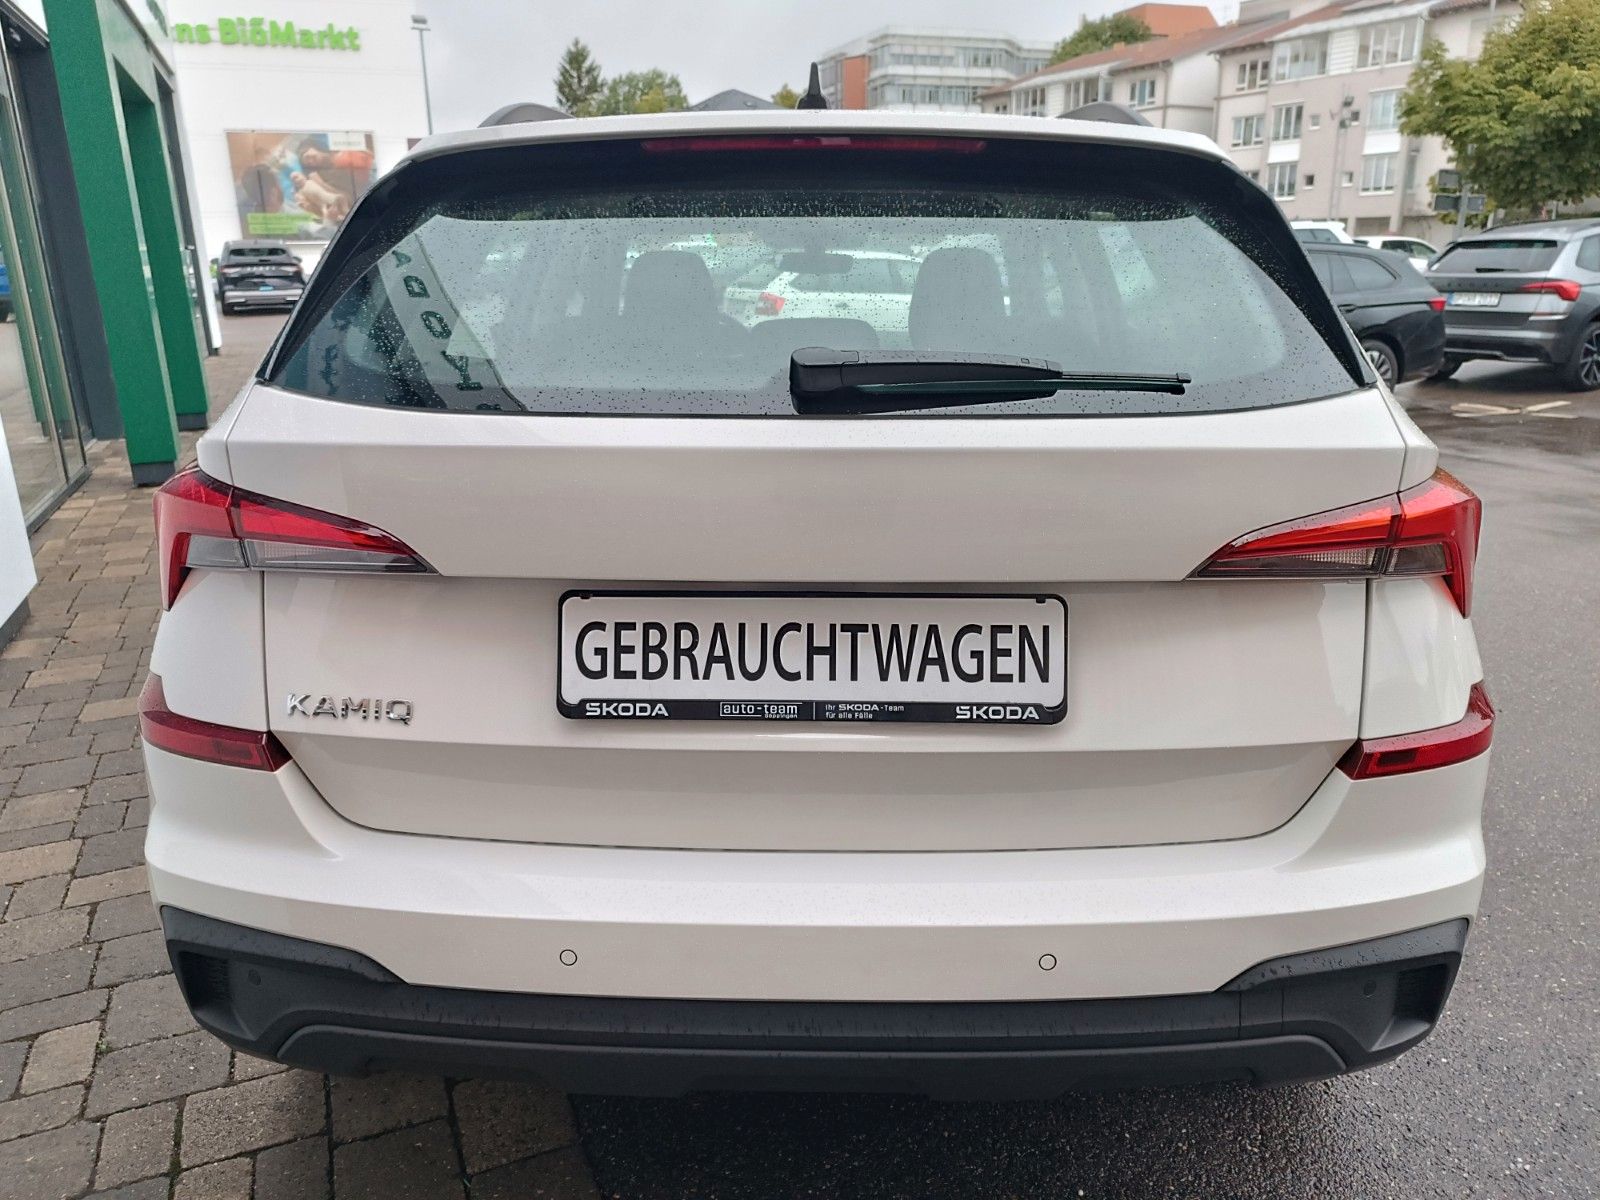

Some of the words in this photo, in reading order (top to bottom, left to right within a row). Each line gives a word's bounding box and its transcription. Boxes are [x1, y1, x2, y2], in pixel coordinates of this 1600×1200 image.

[575, 620, 1050, 684] GEBRAUCHTWAGEN
[287, 693, 413, 725] KAMIQ
[723, 704, 798, 714] auto-team
